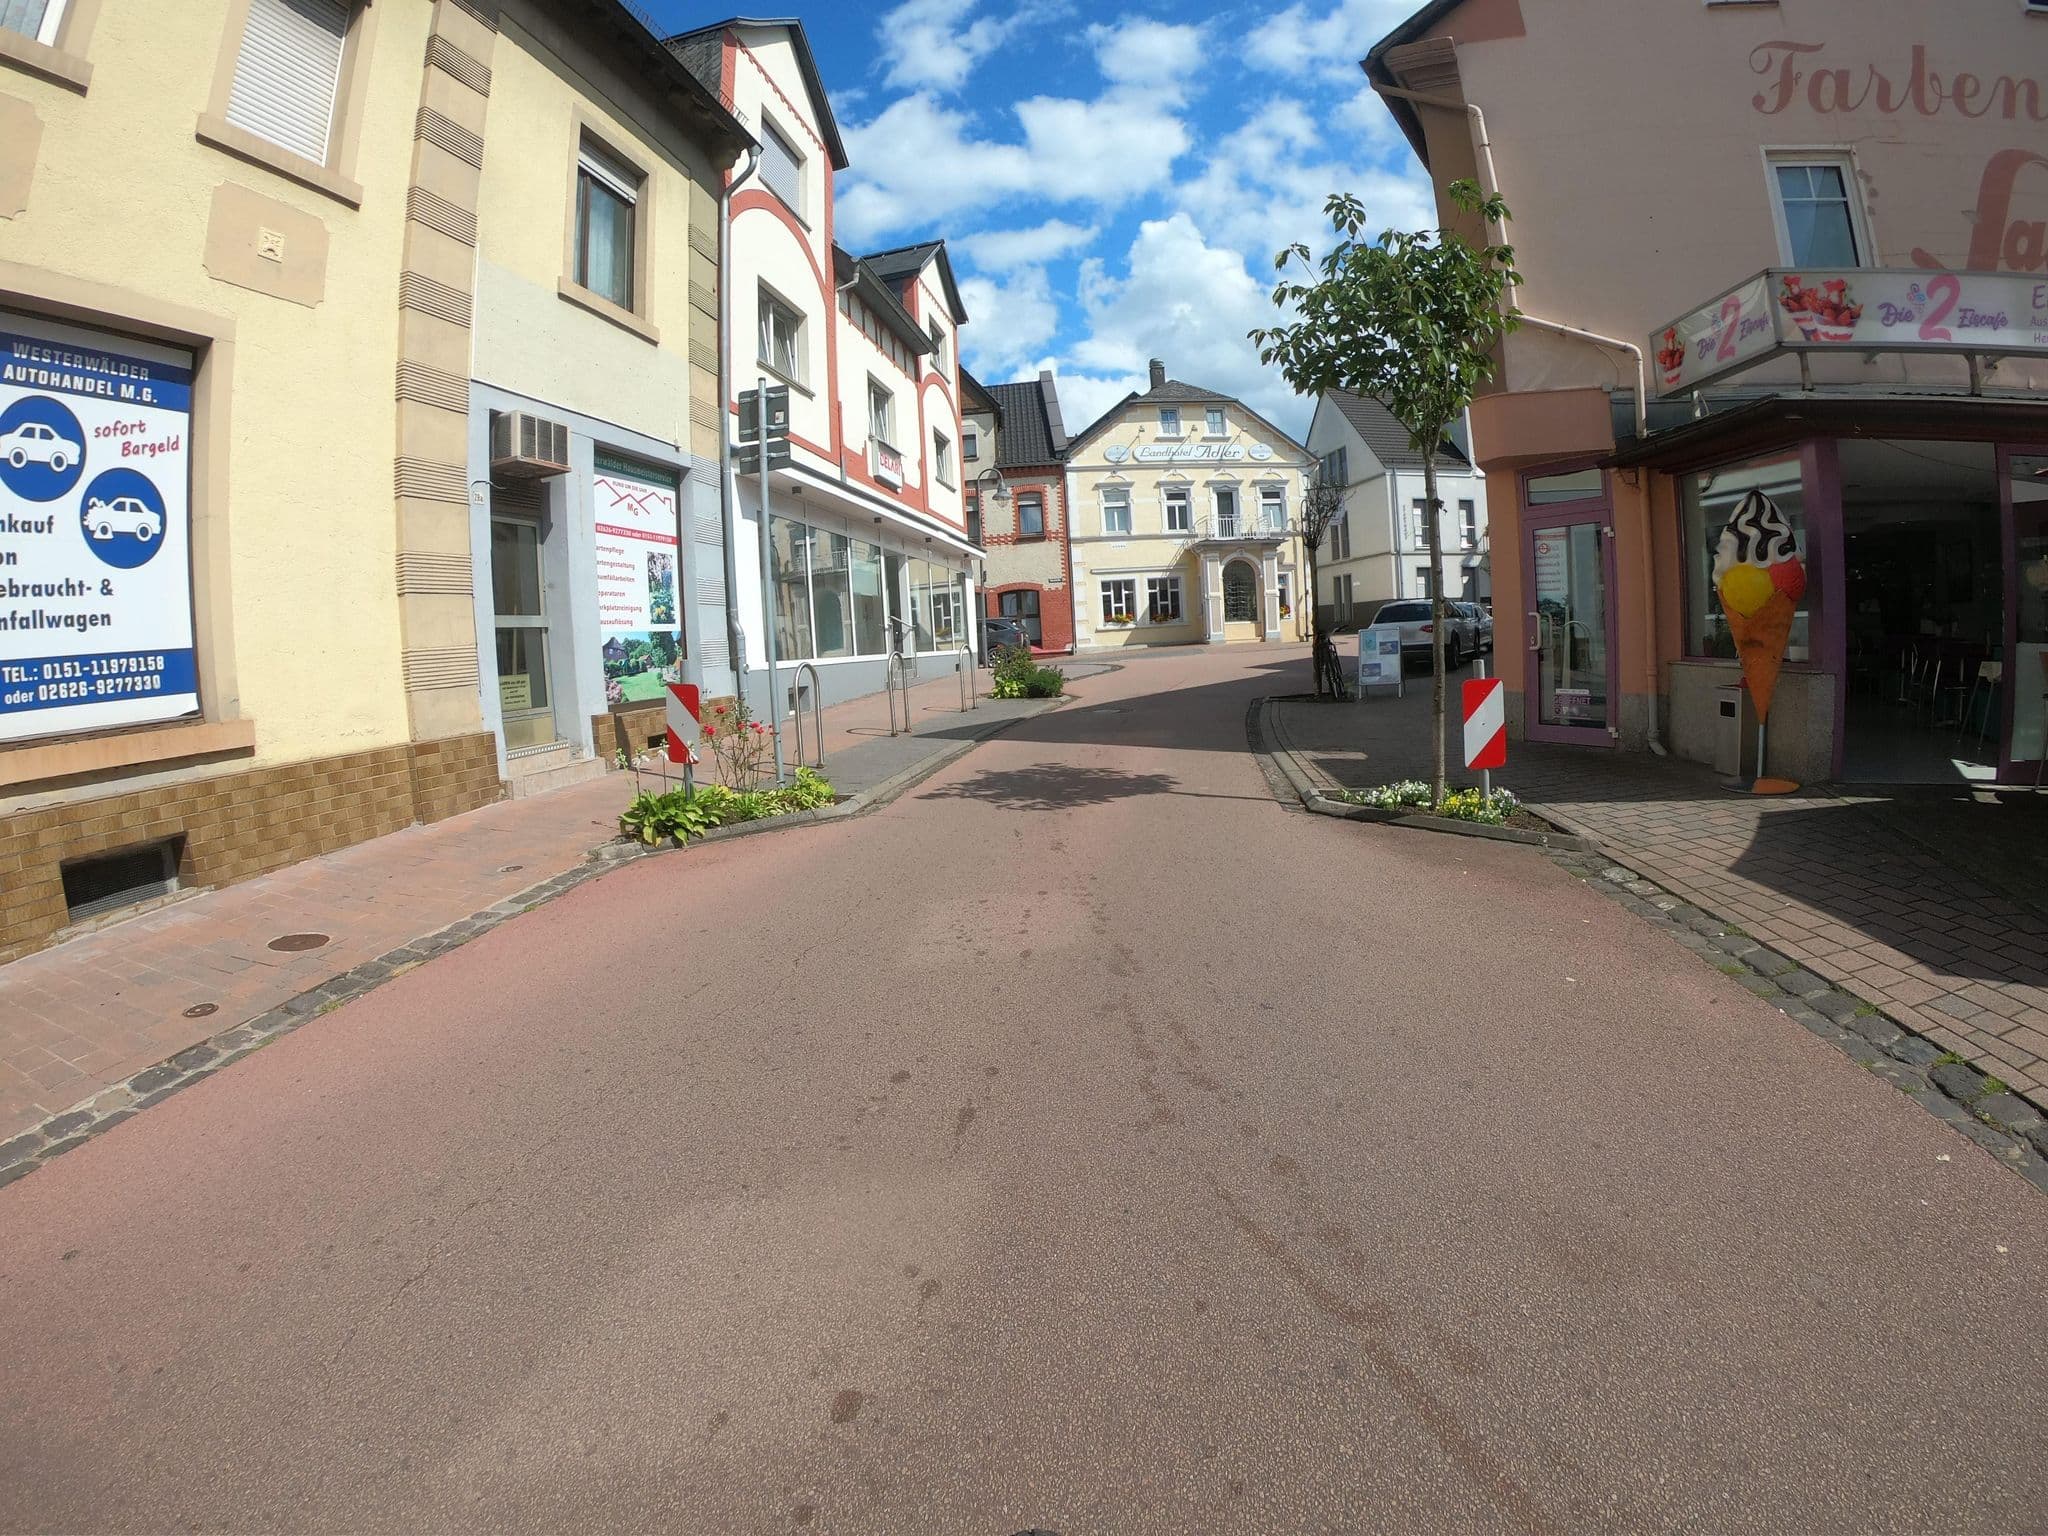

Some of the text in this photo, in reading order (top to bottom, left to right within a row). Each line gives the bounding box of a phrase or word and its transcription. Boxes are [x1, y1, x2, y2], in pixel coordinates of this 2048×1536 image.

[1749, 40, 2048, 122] Farben
[1877, 302, 1915, 327] Die
[1918, 272, 1961, 341] 2
[1716, 294, 1740, 362] 2
[12, 342, 150, 381] WESTERWÄLDER
[3, 363, 158, 403] AUTOHANDEL M.G.
[94, 419, 147, 438] sofort
[121, 434, 180, 458] Bargeld
[1139, 446, 1193, 458] Landhotel
[1194, 444, 1241, 459] Adler
[43, 656, 165, 680] 0151-11979158
[4, 675, 161, 704] oder 02626-9277330
